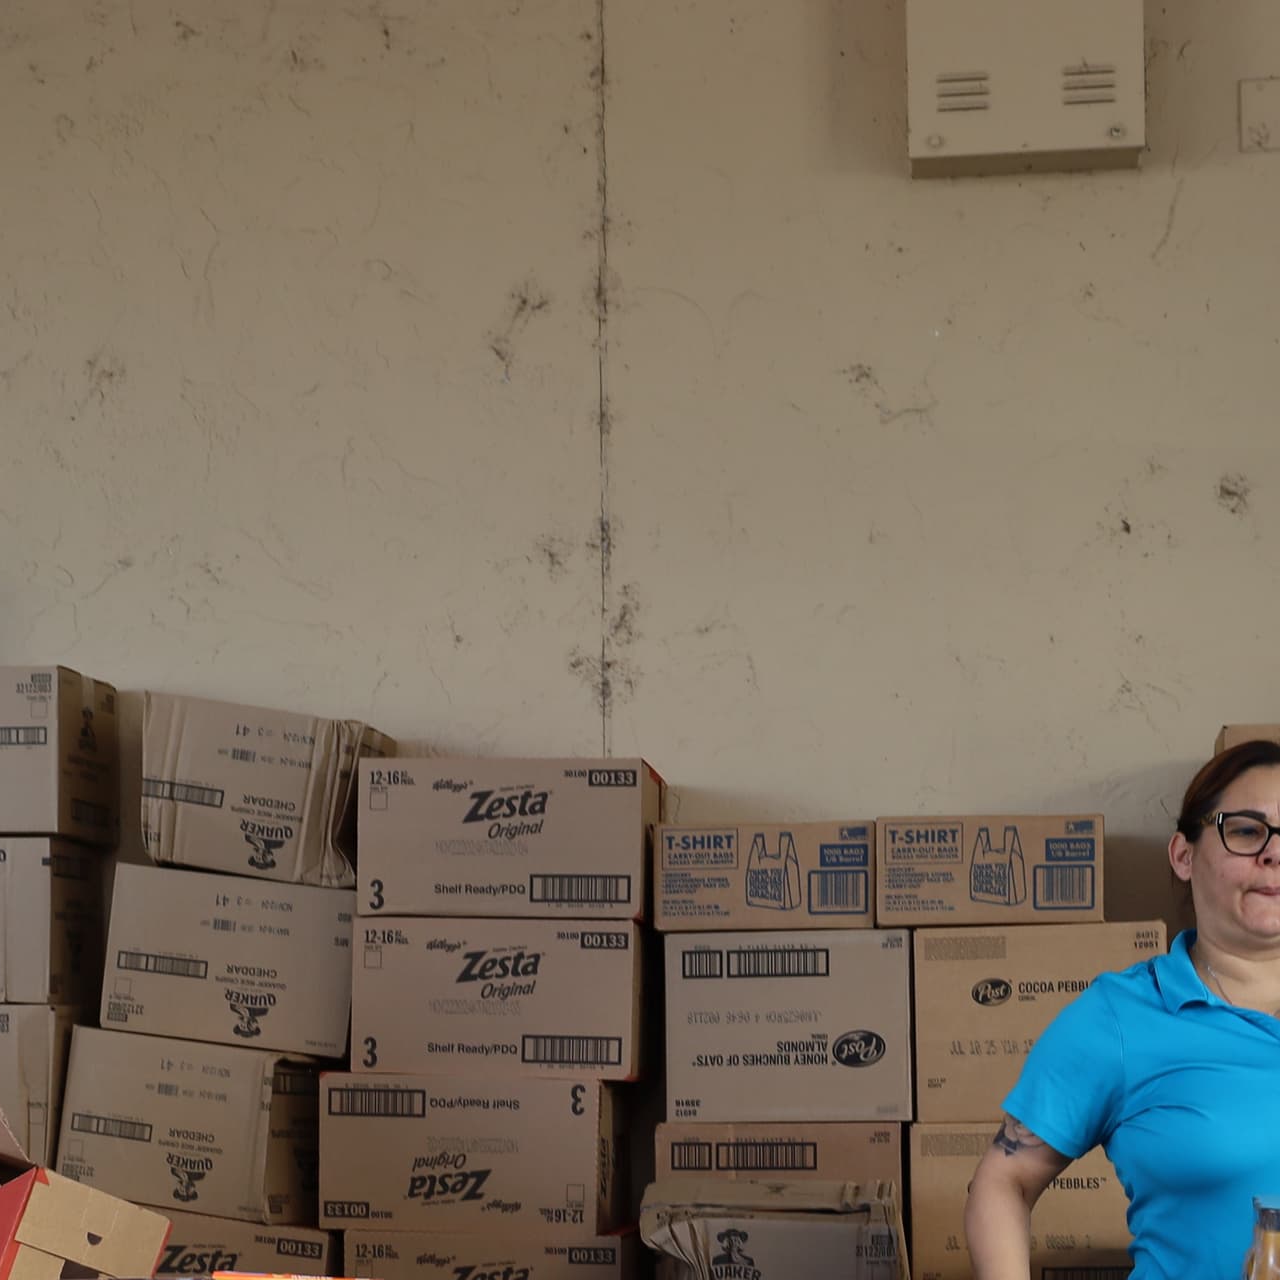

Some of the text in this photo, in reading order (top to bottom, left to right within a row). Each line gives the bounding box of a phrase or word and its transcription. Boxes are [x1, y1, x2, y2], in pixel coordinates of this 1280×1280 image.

[369, 770, 400, 785] 12-16
[591, 772, 634, 785] 00133
[242, 793, 296, 812] CHEDDAR
[462, 789, 549, 823] Zesta
[239, 818, 293, 840] QUAKER
[487, 820, 544, 840] Original
[889, 829, 959, 844] T-SHIRT
[665, 834, 734, 850] T-SHIRT
[369, 879, 385, 910] 3
[434, 884, 526, 896] Shelf Ready/PDQ
[364, 929, 395, 945] 12-16
[583, 934, 626, 948] 00133
[226, 964, 277, 978] CHEDDAR
[455, 950, 542, 983] Zesta
[480, 980, 537, 1000] Original
[1018, 981, 1056, 994] COCOA
[224, 988, 277, 1007] QUAKER
[362, 1036, 378, 1068] 3
[427, 1042, 518, 1056] Shelf Ready/PDQ
[776, 1041, 829, 1053] ALMONDS
[696, 1054, 724, 1067] OATS
[726, 1054, 740, 1066] OF
[742, 1053, 791, 1066] BUNCHES
[793, 1053, 829, 1066] HONEY
[429, 1098, 520, 1110] Shelf Ready/PDQ
[570, 1083, 586, 1115] 3
[168, 1127, 215, 1143] CHEDDAR
[166, 1152, 213, 1171] QUAKER
[412, 1153, 467, 1172] Original
[407, 1169, 492, 1201] Zesta
[1055, 1177, 1101, 1190] PEBBLES
[326, 1204, 368, 1217] 00133
[554, 1208, 585, 1224] 12-16
[279, 1243, 321, 1257] 00133
[355, 1243, 385, 1259] 12-16
[570, 1252, 614, 1264] 00133
[157, 1244, 239, 1275] Zesta
